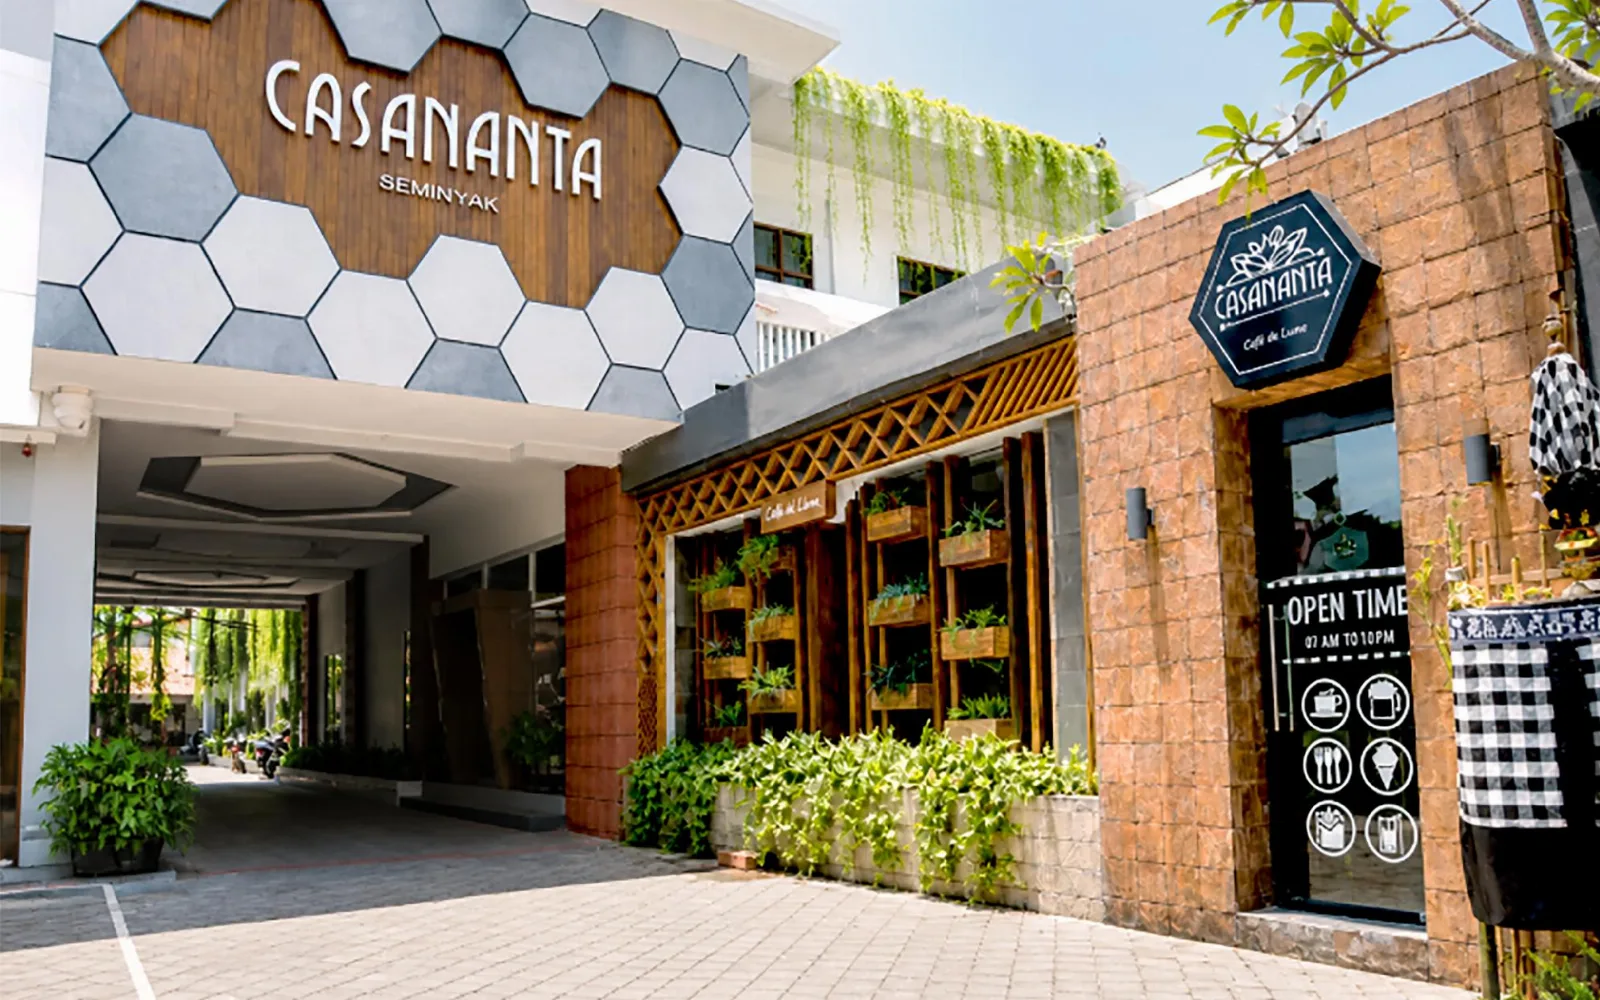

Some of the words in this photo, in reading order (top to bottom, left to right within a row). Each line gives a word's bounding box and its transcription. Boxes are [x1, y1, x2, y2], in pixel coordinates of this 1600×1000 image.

[265, 59, 602, 201] CASANANTA
[378, 172, 500, 213] SEMINYAK
[1214, 257, 1333, 320] CASANANTA
[1287, 592, 1345, 625] OPEN
[1352, 585, 1408, 619] TIME
[1305, 635, 1318, 649] 07
[1321, 633, 1340, 648] AM
[1342, 631, 1359, 646] TO
